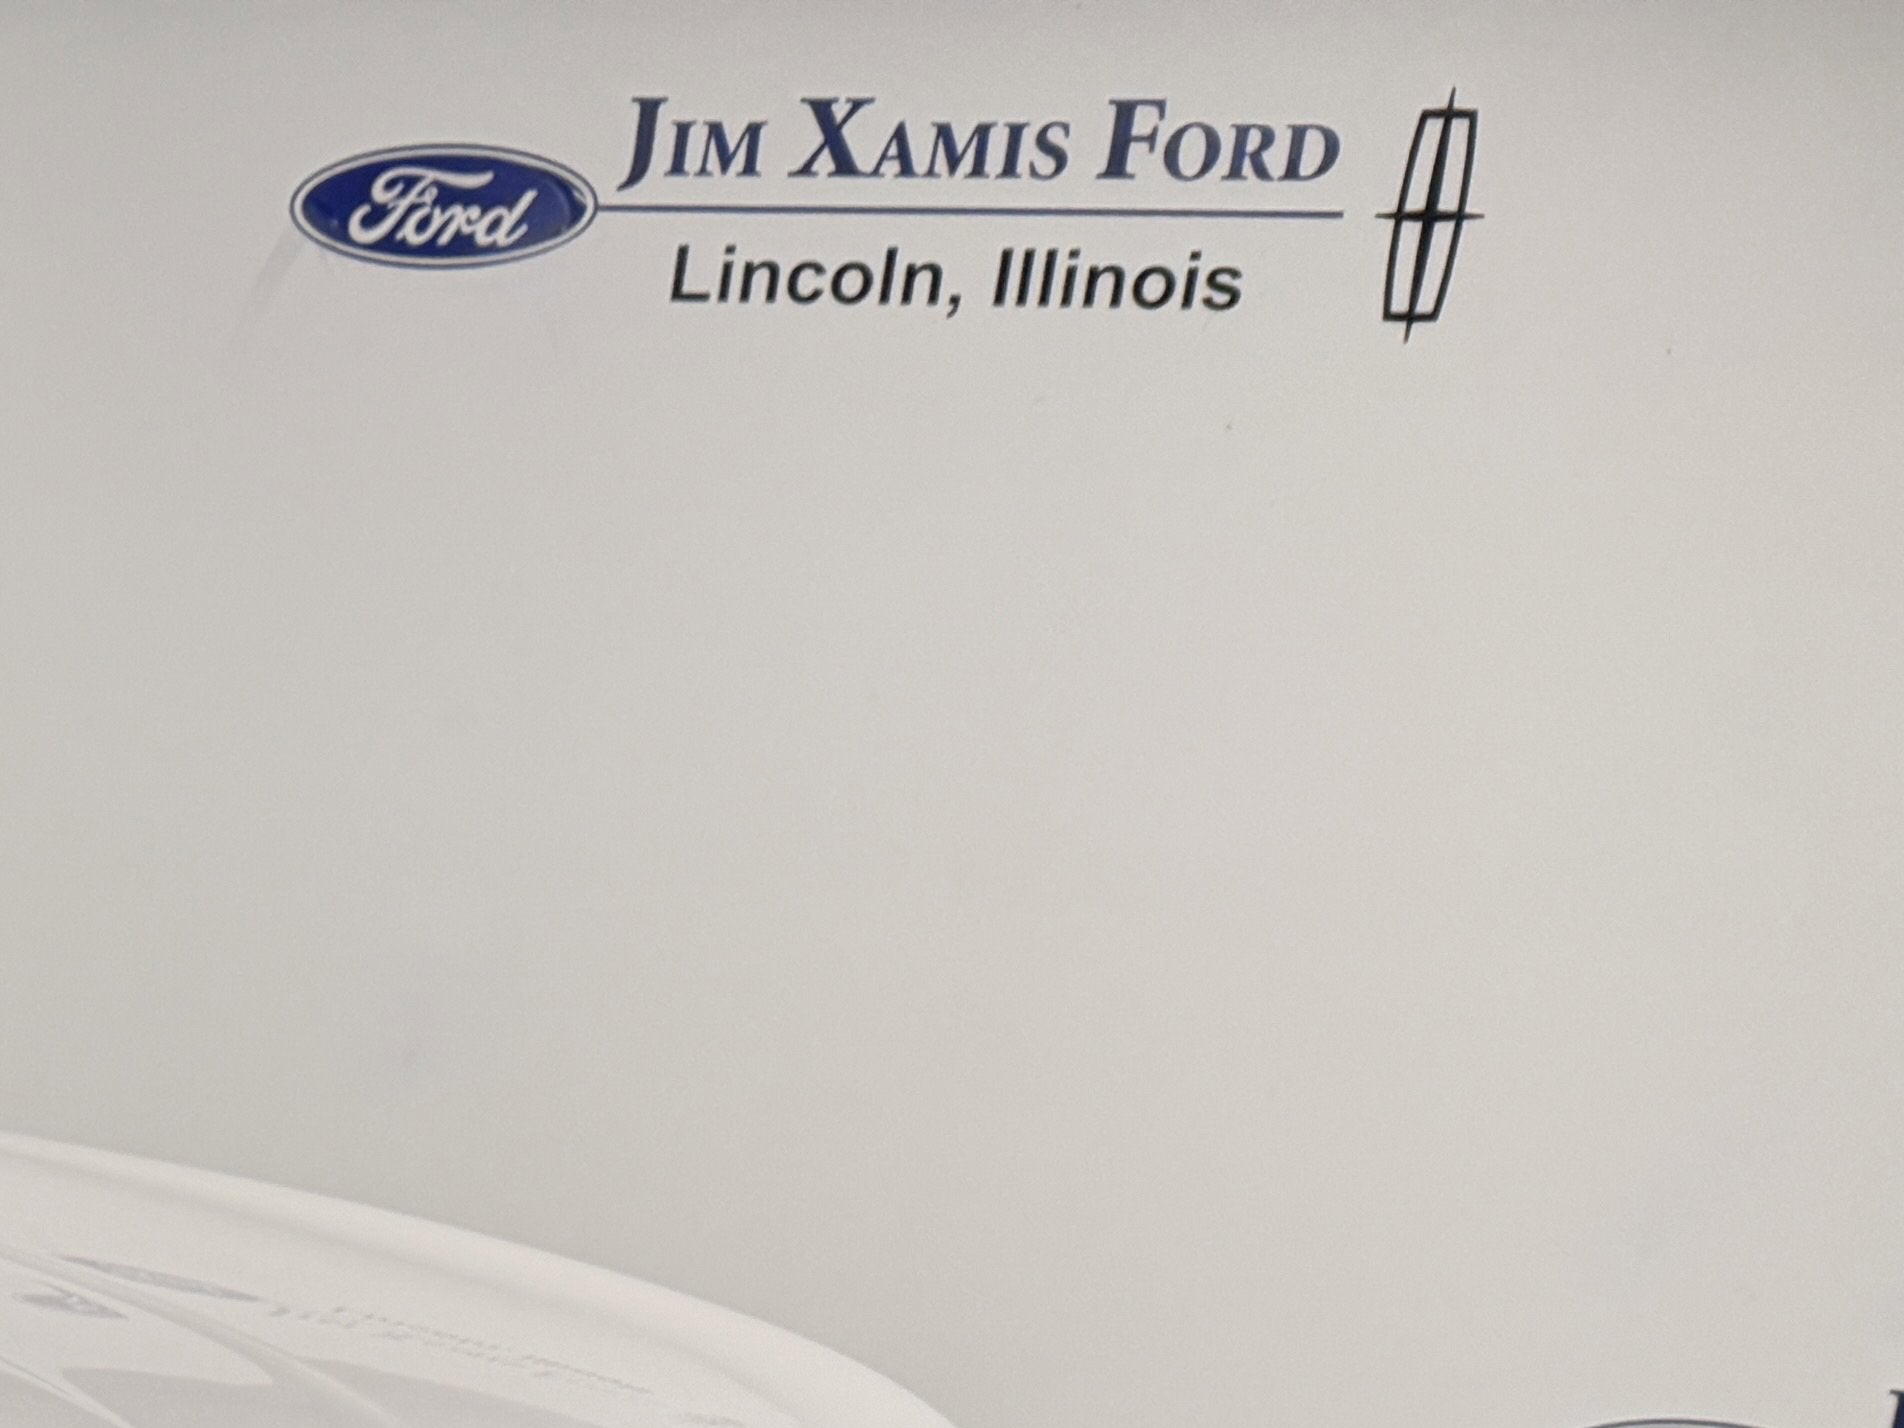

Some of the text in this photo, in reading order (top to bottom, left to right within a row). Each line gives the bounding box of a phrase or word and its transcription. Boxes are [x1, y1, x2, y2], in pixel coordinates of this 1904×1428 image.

[350, 168, 529, 253] Ford
[670, 244, 1243, 318] Lincoln, Illinois
